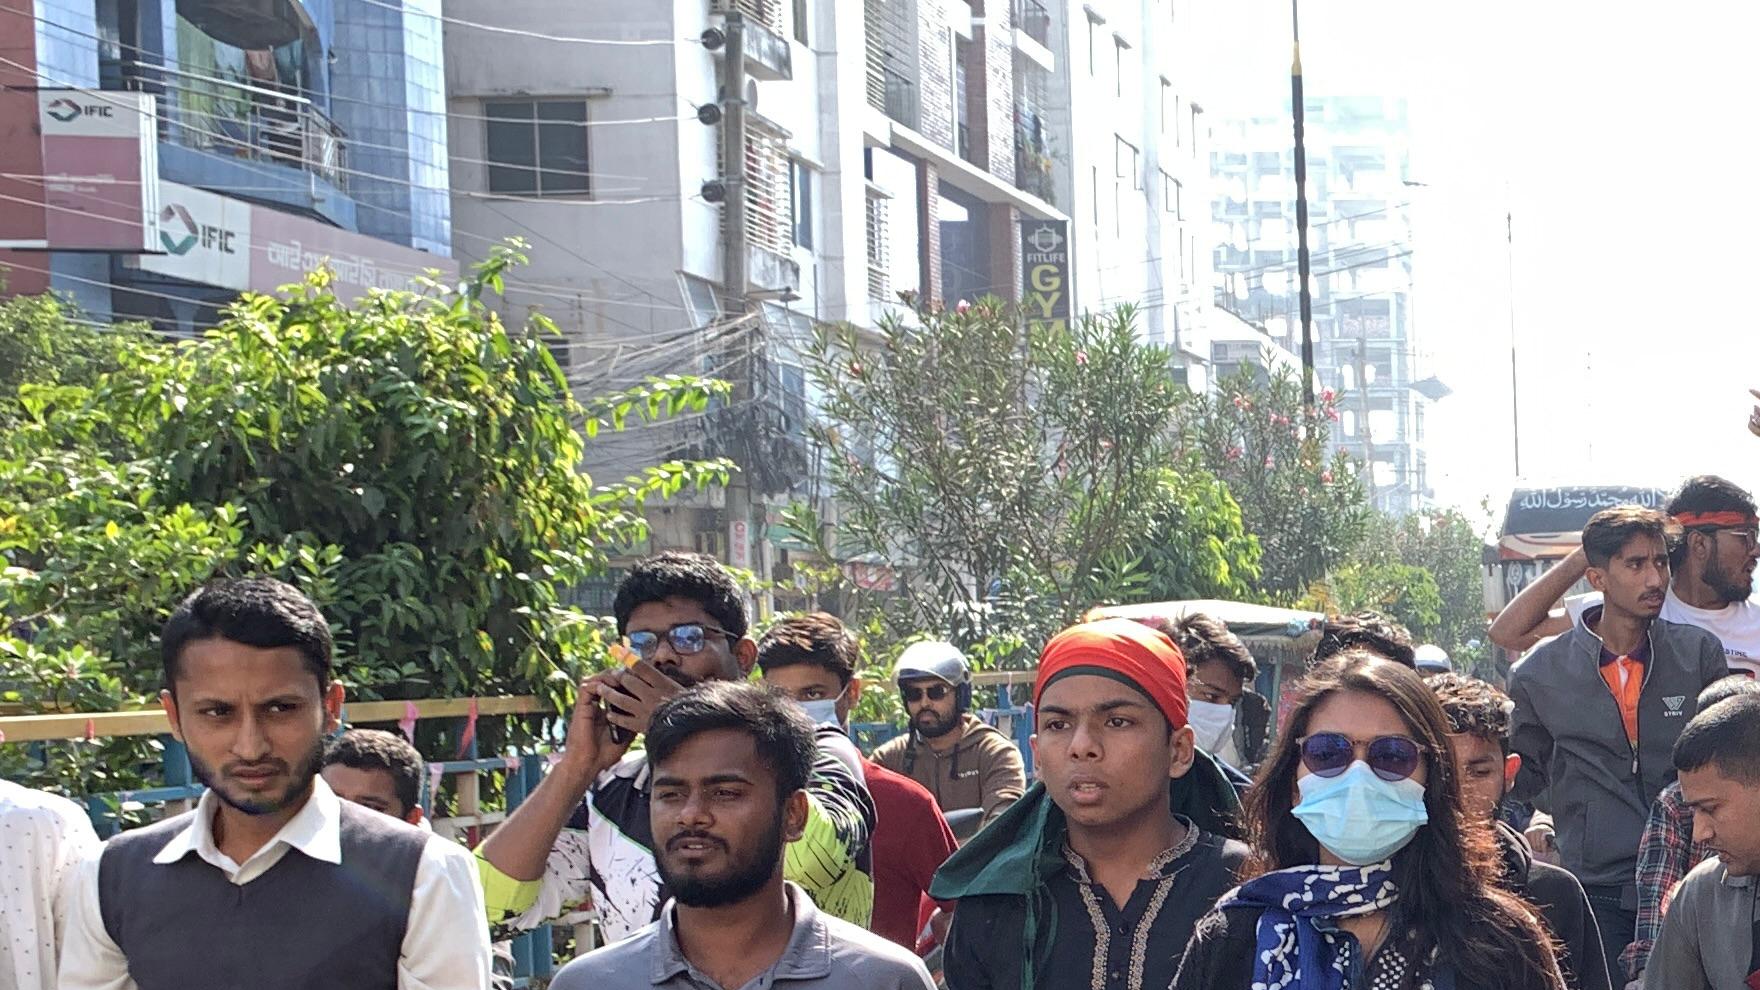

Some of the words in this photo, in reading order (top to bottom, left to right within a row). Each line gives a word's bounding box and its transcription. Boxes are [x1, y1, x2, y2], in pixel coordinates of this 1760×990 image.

[84, 105, 113, 118] IFIC
[201, 224, 235, 254] IFIC
[1027, 252, 1065, 263] FITLIFE
